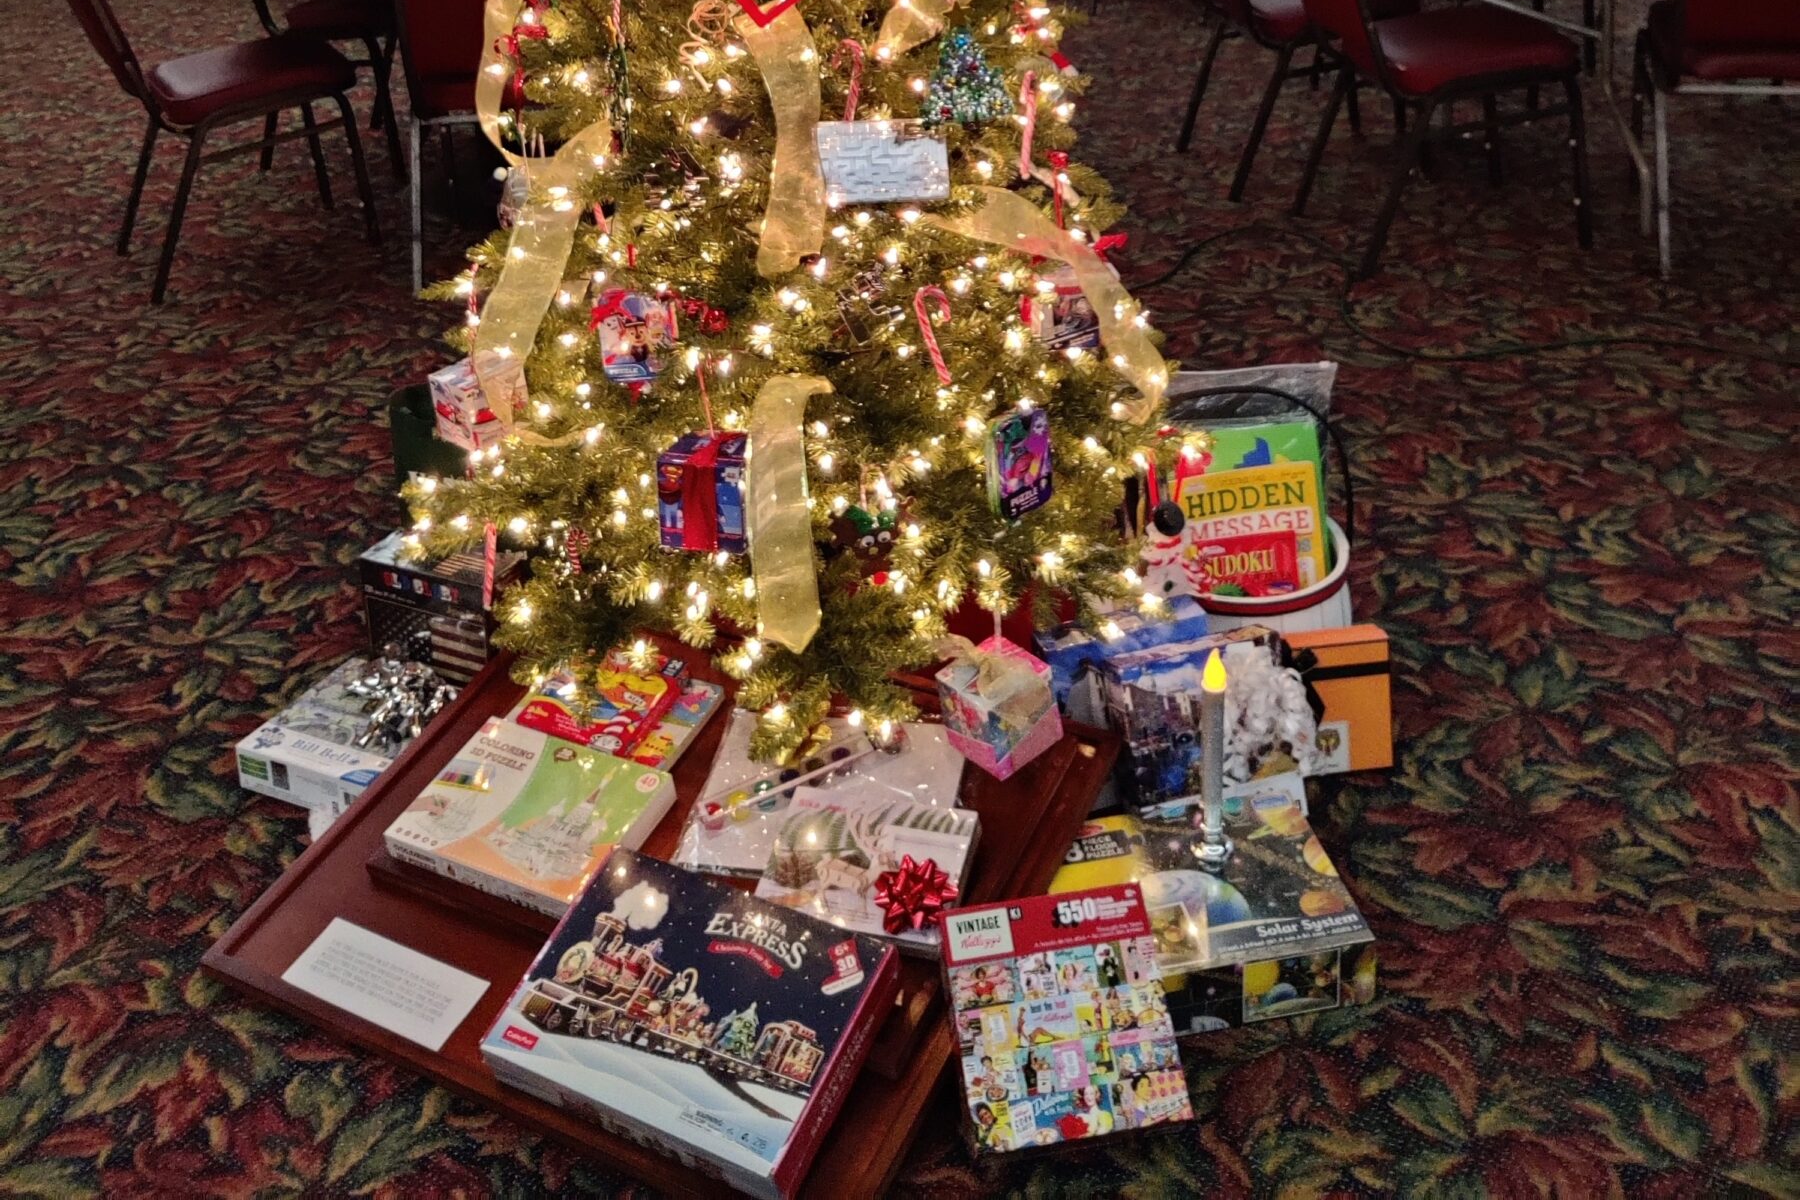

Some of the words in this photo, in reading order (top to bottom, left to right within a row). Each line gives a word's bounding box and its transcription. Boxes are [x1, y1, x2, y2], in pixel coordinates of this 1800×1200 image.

[1185, 480, 1306, 519] HIDDEN
[1189, 509, 1310, 541] MESSAGE
[1204, 549, 1277, 578] SUDOKU
[640, 775, 657, 787] 40
[1082, 834, 1112, 846] PIECE
[1084, 841, 1119, 852] FLOOR
[1086, 846, 1125, 860] PUZZLE
[1057, 897, 1096, 925] 550
[956, 915, 1001, 935] VINTAGE
[1256, 922, 1299, 938] Solar
[1300, 913, 1359, 932] System
[836, 955, 857, 971] 3D
